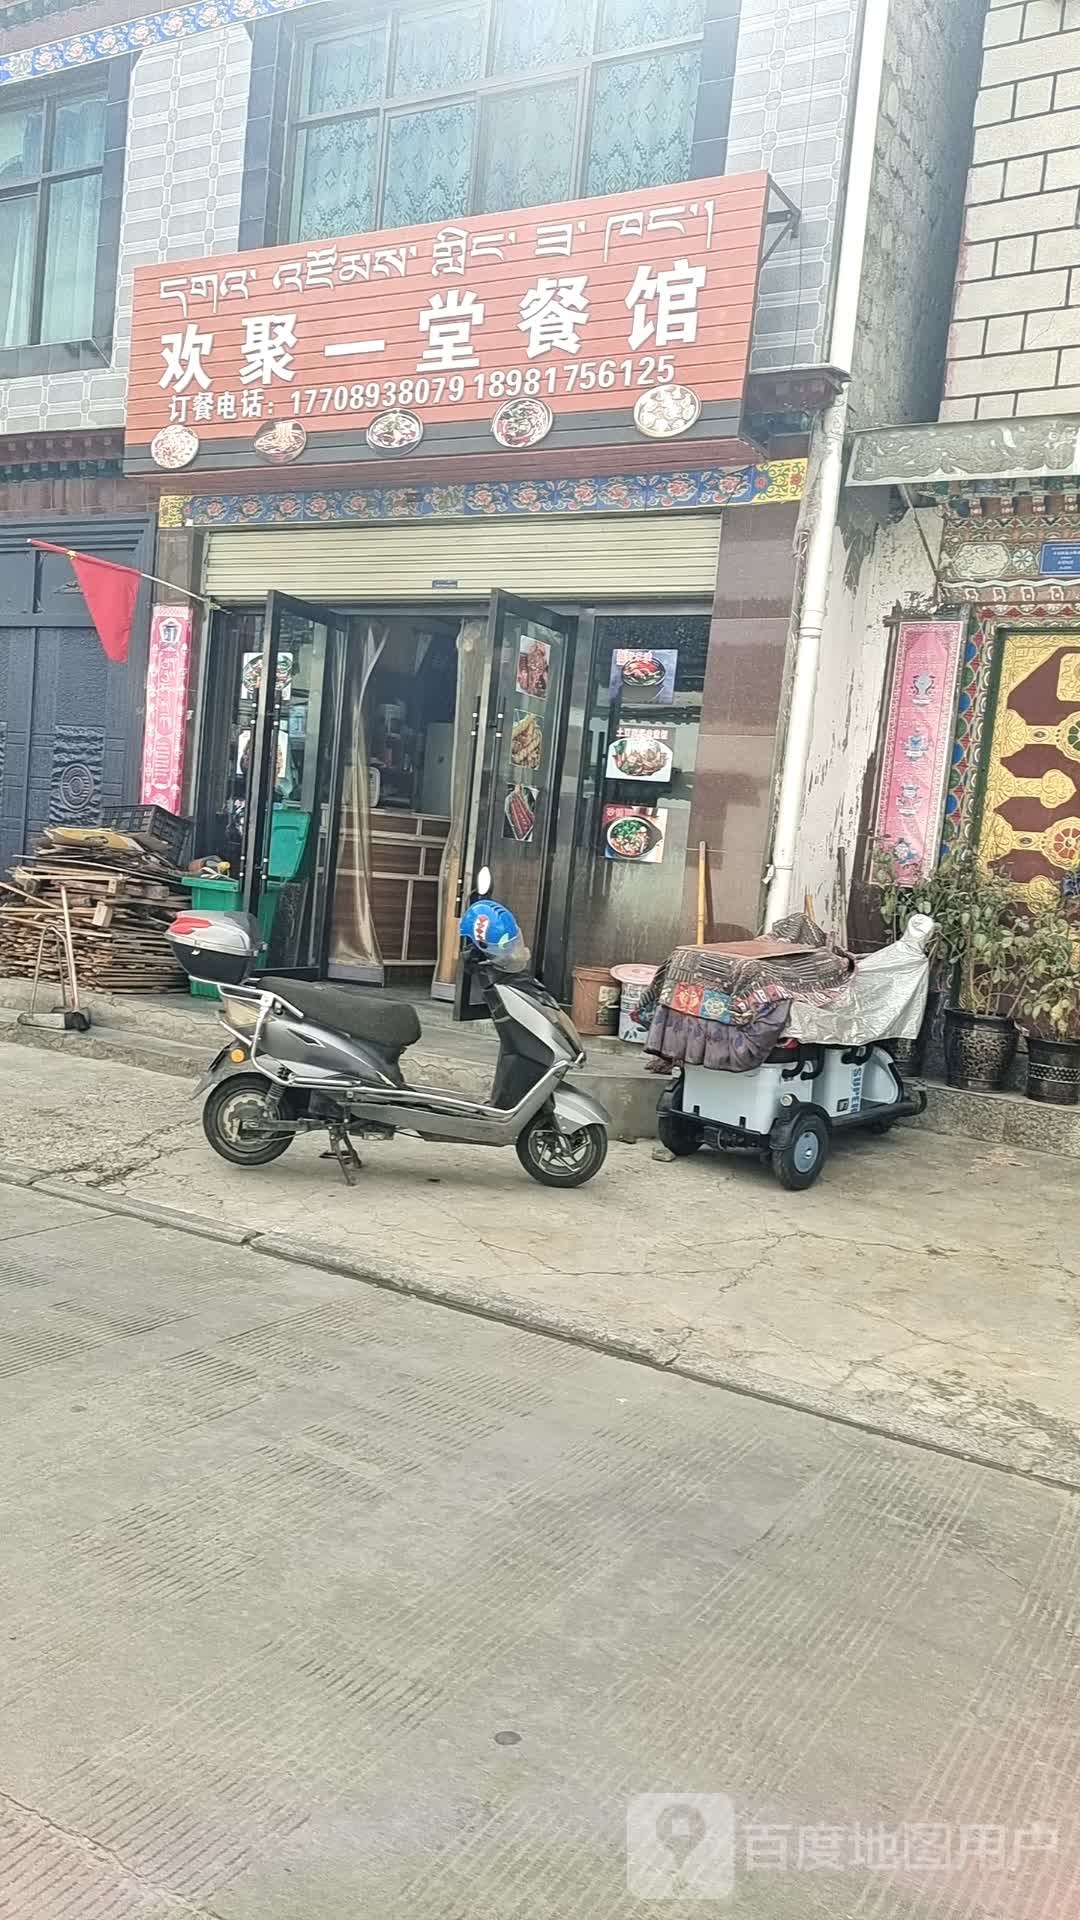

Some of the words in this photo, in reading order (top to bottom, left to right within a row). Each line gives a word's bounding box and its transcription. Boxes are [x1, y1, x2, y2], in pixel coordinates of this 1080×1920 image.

[157, 257, 708, 393] 欢聚一堂餐馆
[169, 388, 274, 424] 订餐电话：
[290, 374, 463, 415] 17708938079
[474, 354, 676, 401] 18981756125
